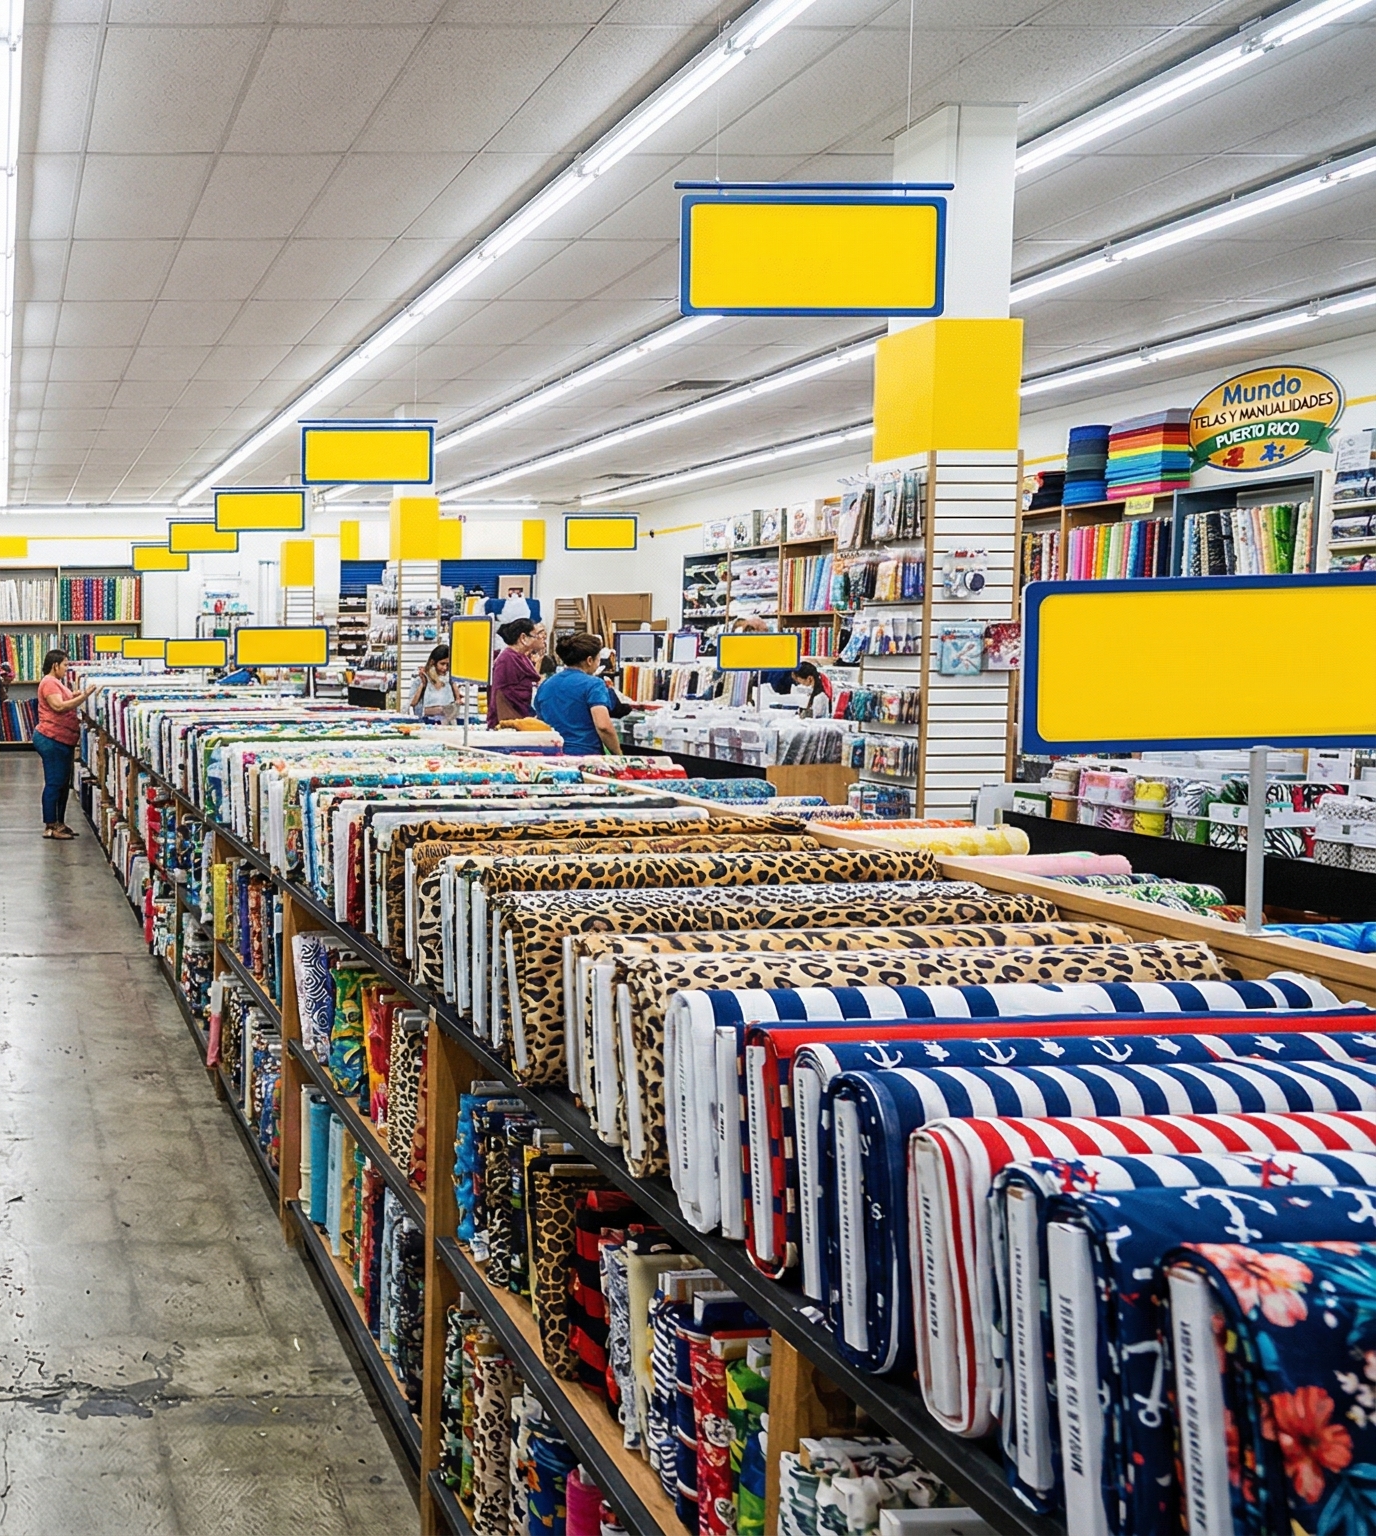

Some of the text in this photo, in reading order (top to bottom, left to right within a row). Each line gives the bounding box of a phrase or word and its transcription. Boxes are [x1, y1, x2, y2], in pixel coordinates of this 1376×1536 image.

[1222, 373, 1302, 407] Mundo
[1193, 391, 1334, 430] TELAS Y MANUALIDADES
[1215, 421, 1300, 449] PUERTO RICO
